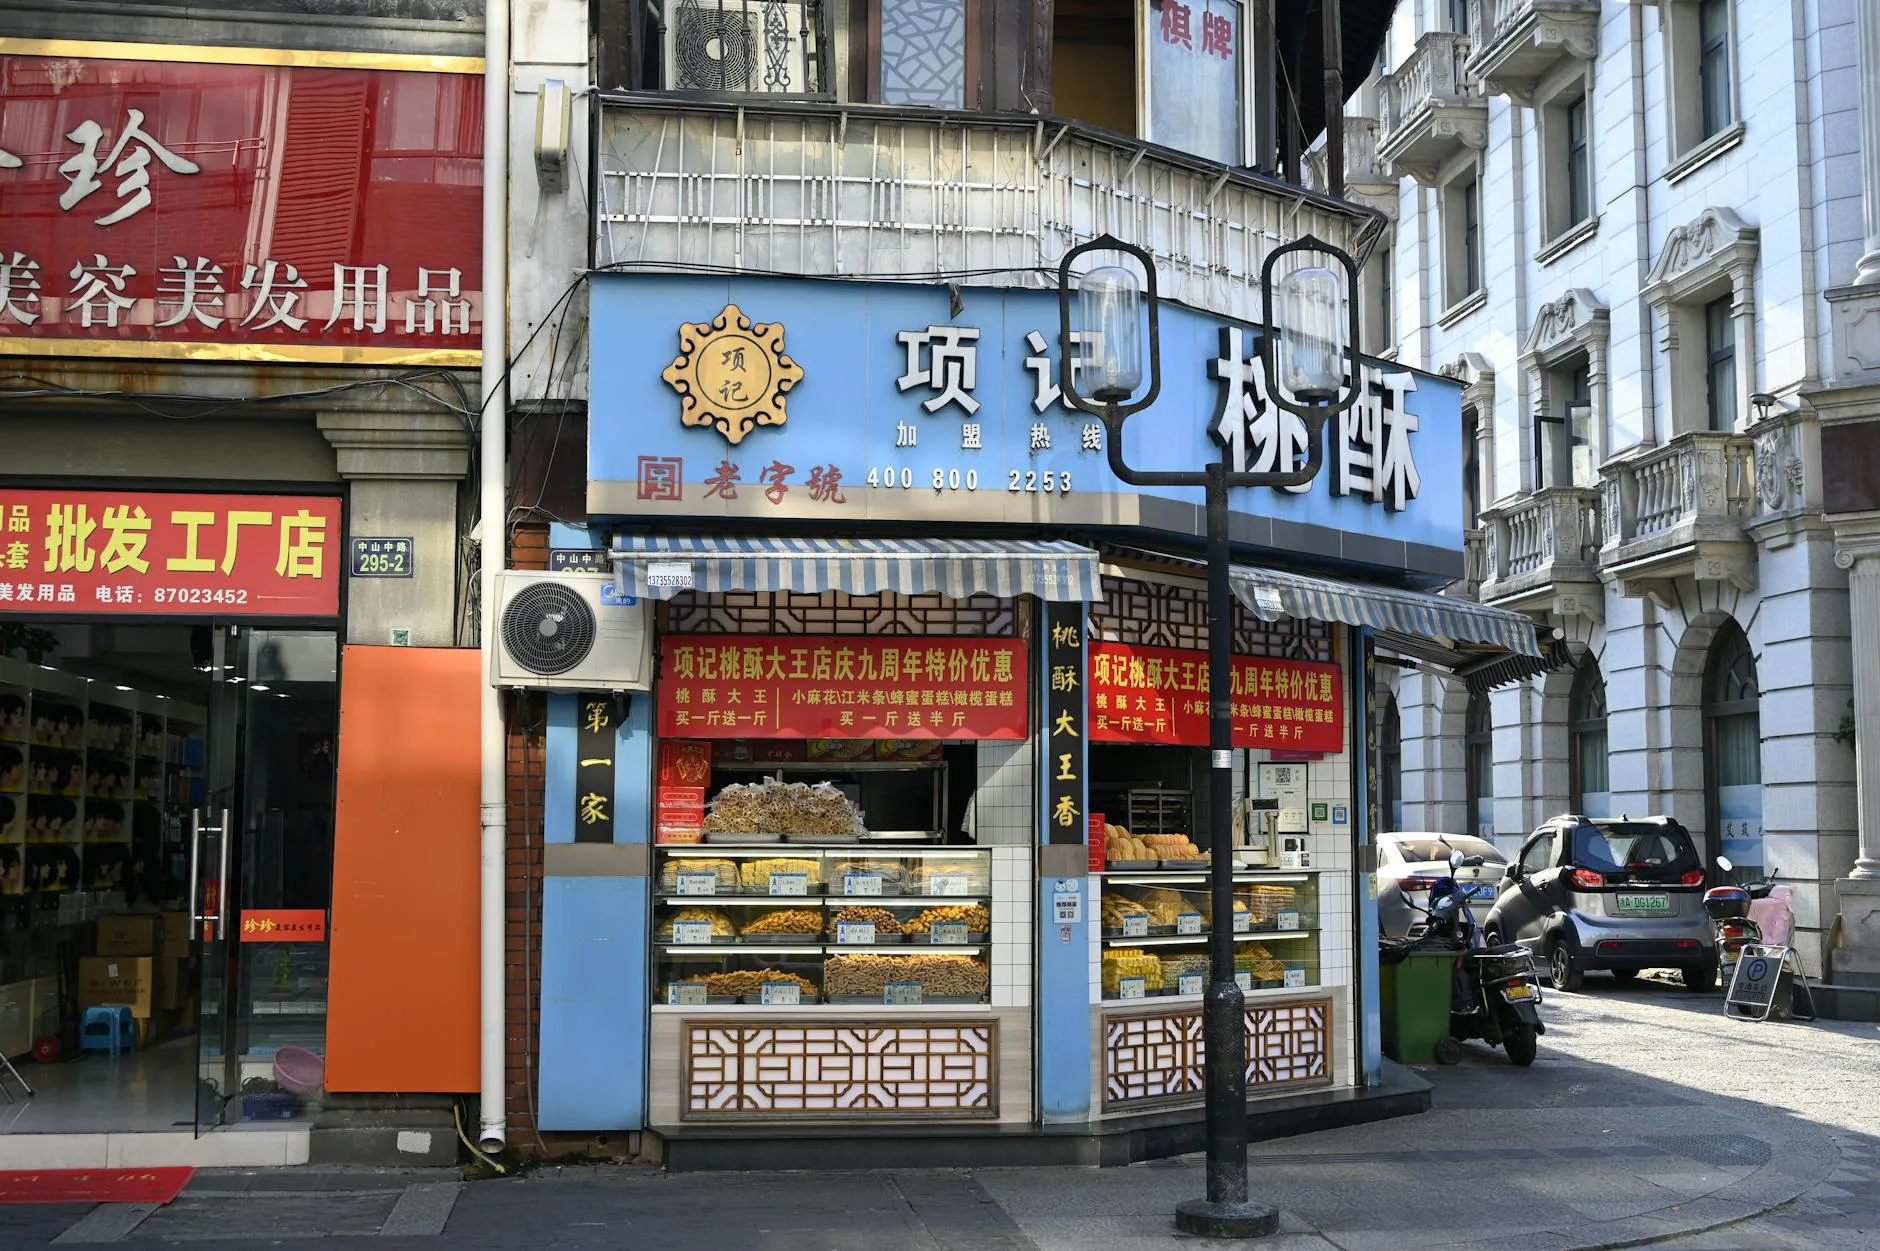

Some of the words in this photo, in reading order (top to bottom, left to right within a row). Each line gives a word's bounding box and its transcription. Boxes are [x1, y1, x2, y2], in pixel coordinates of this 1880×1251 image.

[1160, 0, 1233, 60] 棋牌
[0, 108, 200, 226] 珍
[0, 252, 471, 334] 美容美发用品
[719, 346, 749, 403] 项记
[896, 421, 1103, 449] 加盟热线
[703, 459, 847, 505] 老字號
[866, 466, 913, 489] 400
[932, 467, 978, 491] 800
[1008, 469, 1072, 492] 2253
[0, 504, 30, 533] 品
[358, 541, 407, 552] 中山中路
[556, 553, 605, 564] 中山中路
[360, 554, 404, 572] 295-2
[0, 582, 76, 602] 美发用品
[648, 575, 692, 586] 13735528302
[673, 646, 1014, 682] 项记桃酥大王店庆九周年特价优惠
[1094, 654, 1333, 702] 项记桃酥大王店九周年特价优惠
[675, 688, 768, 704] 桃酥大王
[1096, 693, 1166, 711] 桃酥大王
[675, 710, 767, 727] 买一斤送一斤
[839, 711, 967, 727] 买一斤送半斤
[1051, 620, 1081, 828] 桃酥大王香
[1096, 715, 1167, 733] 买一斤送一斤
[1233, 723, 1304, 740] 一斤送半斤
[580, 702, 612, 825] 第一家
